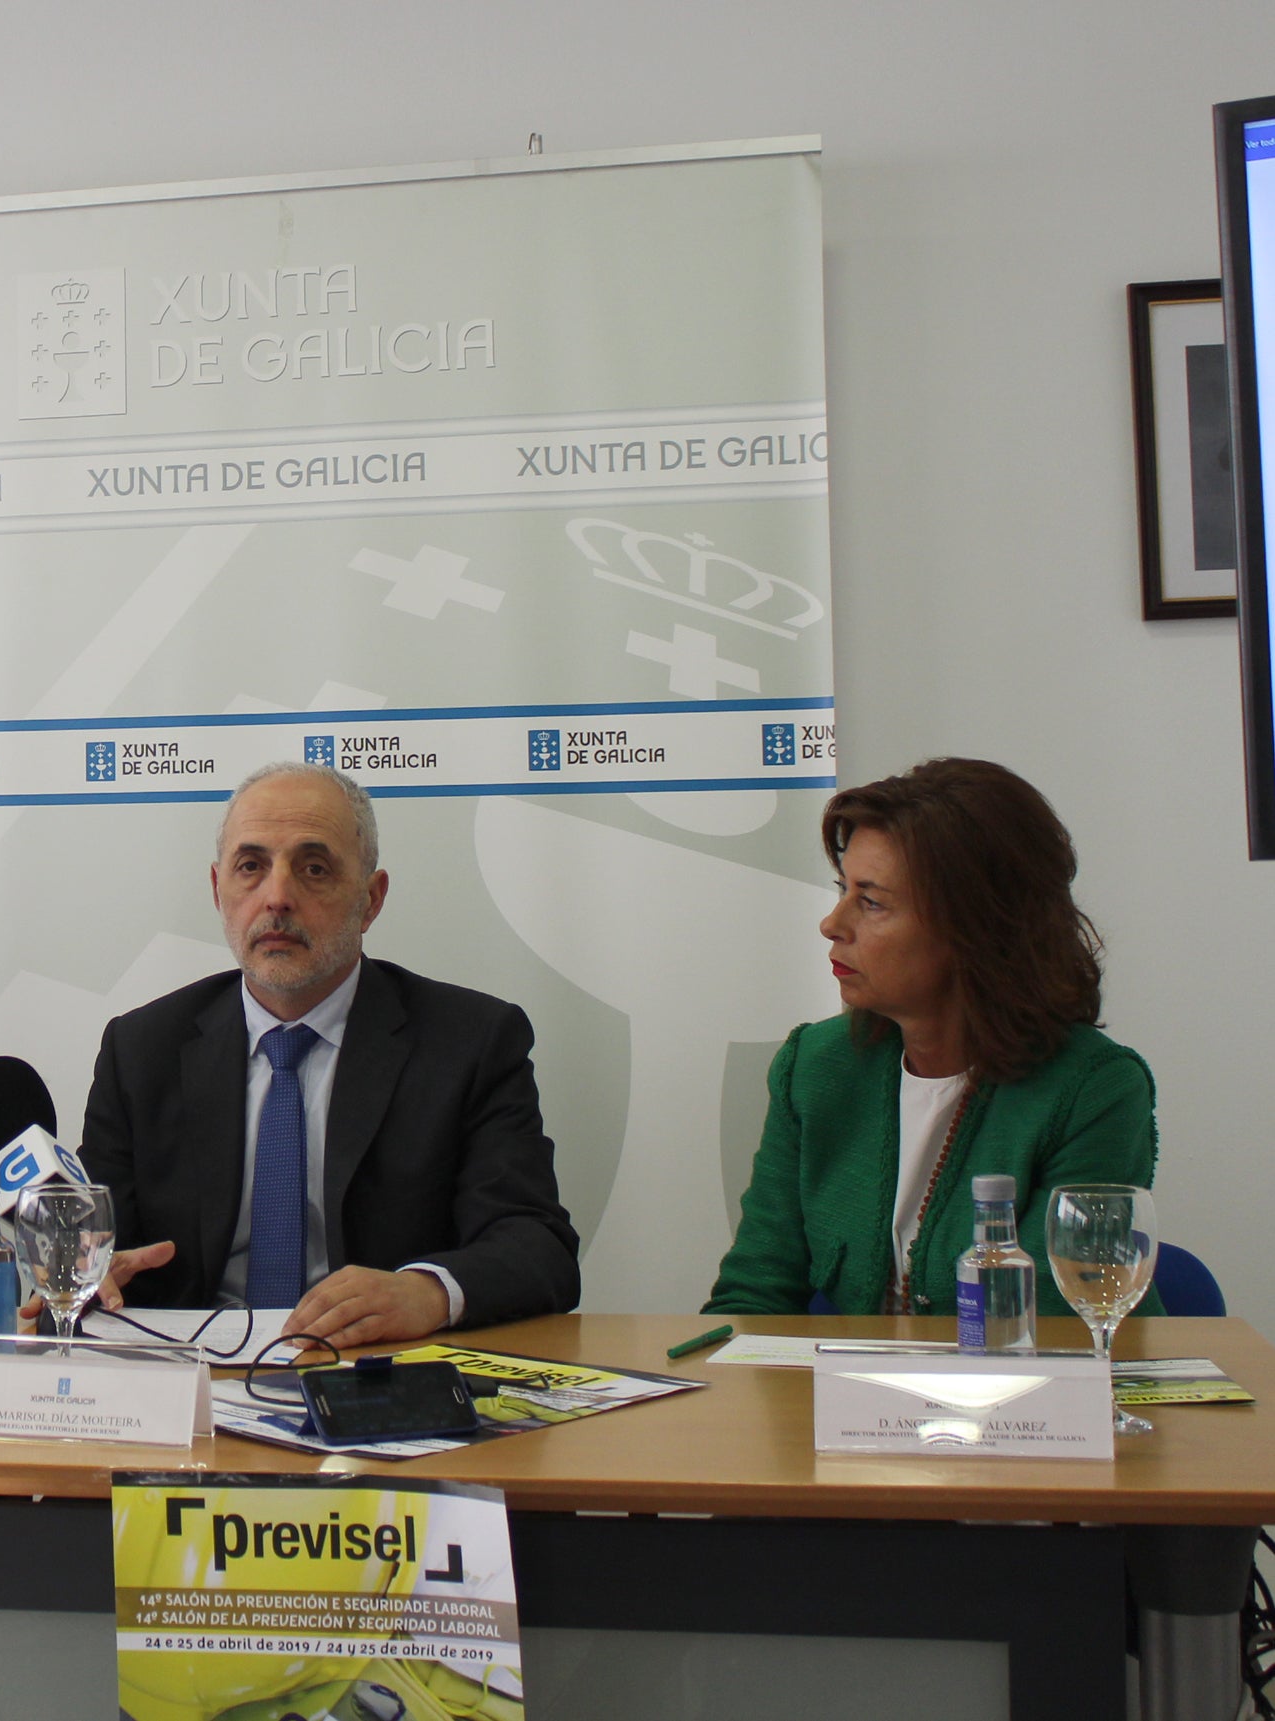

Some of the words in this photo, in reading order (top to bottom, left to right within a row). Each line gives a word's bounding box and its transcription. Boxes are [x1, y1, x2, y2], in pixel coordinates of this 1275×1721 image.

[150, 263, 357, 325] XUNTA
[150, 335, 224, 388] DE
[243, 318, 496, 383] GALICIA
[516, 441, 647, 478] XUNTA
[659, 438, 706, 471] DE
[87, 463, 208, 498] XUNTA
[221, 460, 265, 492] DE
[276, 452, 426, 488] GALICIA
[341, 736, 400, 752] XUNTA
[567, 730, 628, 747] XUNTA
[122, 743, 179, 758] XUNTA
[567, 749, 589, 765] DE
[594, 747, 665, 764] GALICIA
[802, 744, 823, 759] DE
[122, 761, 142, 775] DE
[147, 759, 214, 774] GALICIA
[341, 755, 362, 770] DE
[367, 753, 437, 770] GALICIA
[56, 1396, 65, 1404] DE
[51, 1411, 78, 1424] DÍAZ
[81, 1415, 142, 1428] MOUTEIRA
[213, 1512, 416, 1571] previsel
[166, 1591, 210, 1607] SALÓN
[214, 1595, 233, 1607] DA
[332, 1597, 340, 1610] E
[344, 1597, 431, 1614] SEGURIDADE
[434, 1601, 496, 1620] LABORAL
[161, 1609, 206, 1625] SALÓN
[211, 1612, 228, 1626] DE
[232, 1613, 248, 1626] LA
[347, 1616, 354, 1629] Y
[358, 1616, 437, 1632] SEGURIDAD
[441, 1621, 501, 1638] LABORAL
[145, 1637, 161, 1649] 24
[165, 1639, 173, 1649] e
[177, 1638, 193, 1649] 25
[197, 1636, 214, 1650] de
[219, 1637, 251, 1651] abril
[256, 1638, 273, 1651] de
[278, 1640, 310, 1653] 2019
[327, 1642, 342, 1654] 24
[347, 1644, 355, 1657] y
[360, 1643, 375, 1655] 25
[380, 1642, 397, 1656] de
[402, 1643, 436, 1657] abril
[440, 1644, 457, 1658] de
[461, 1648, 493, 1662] 2019
